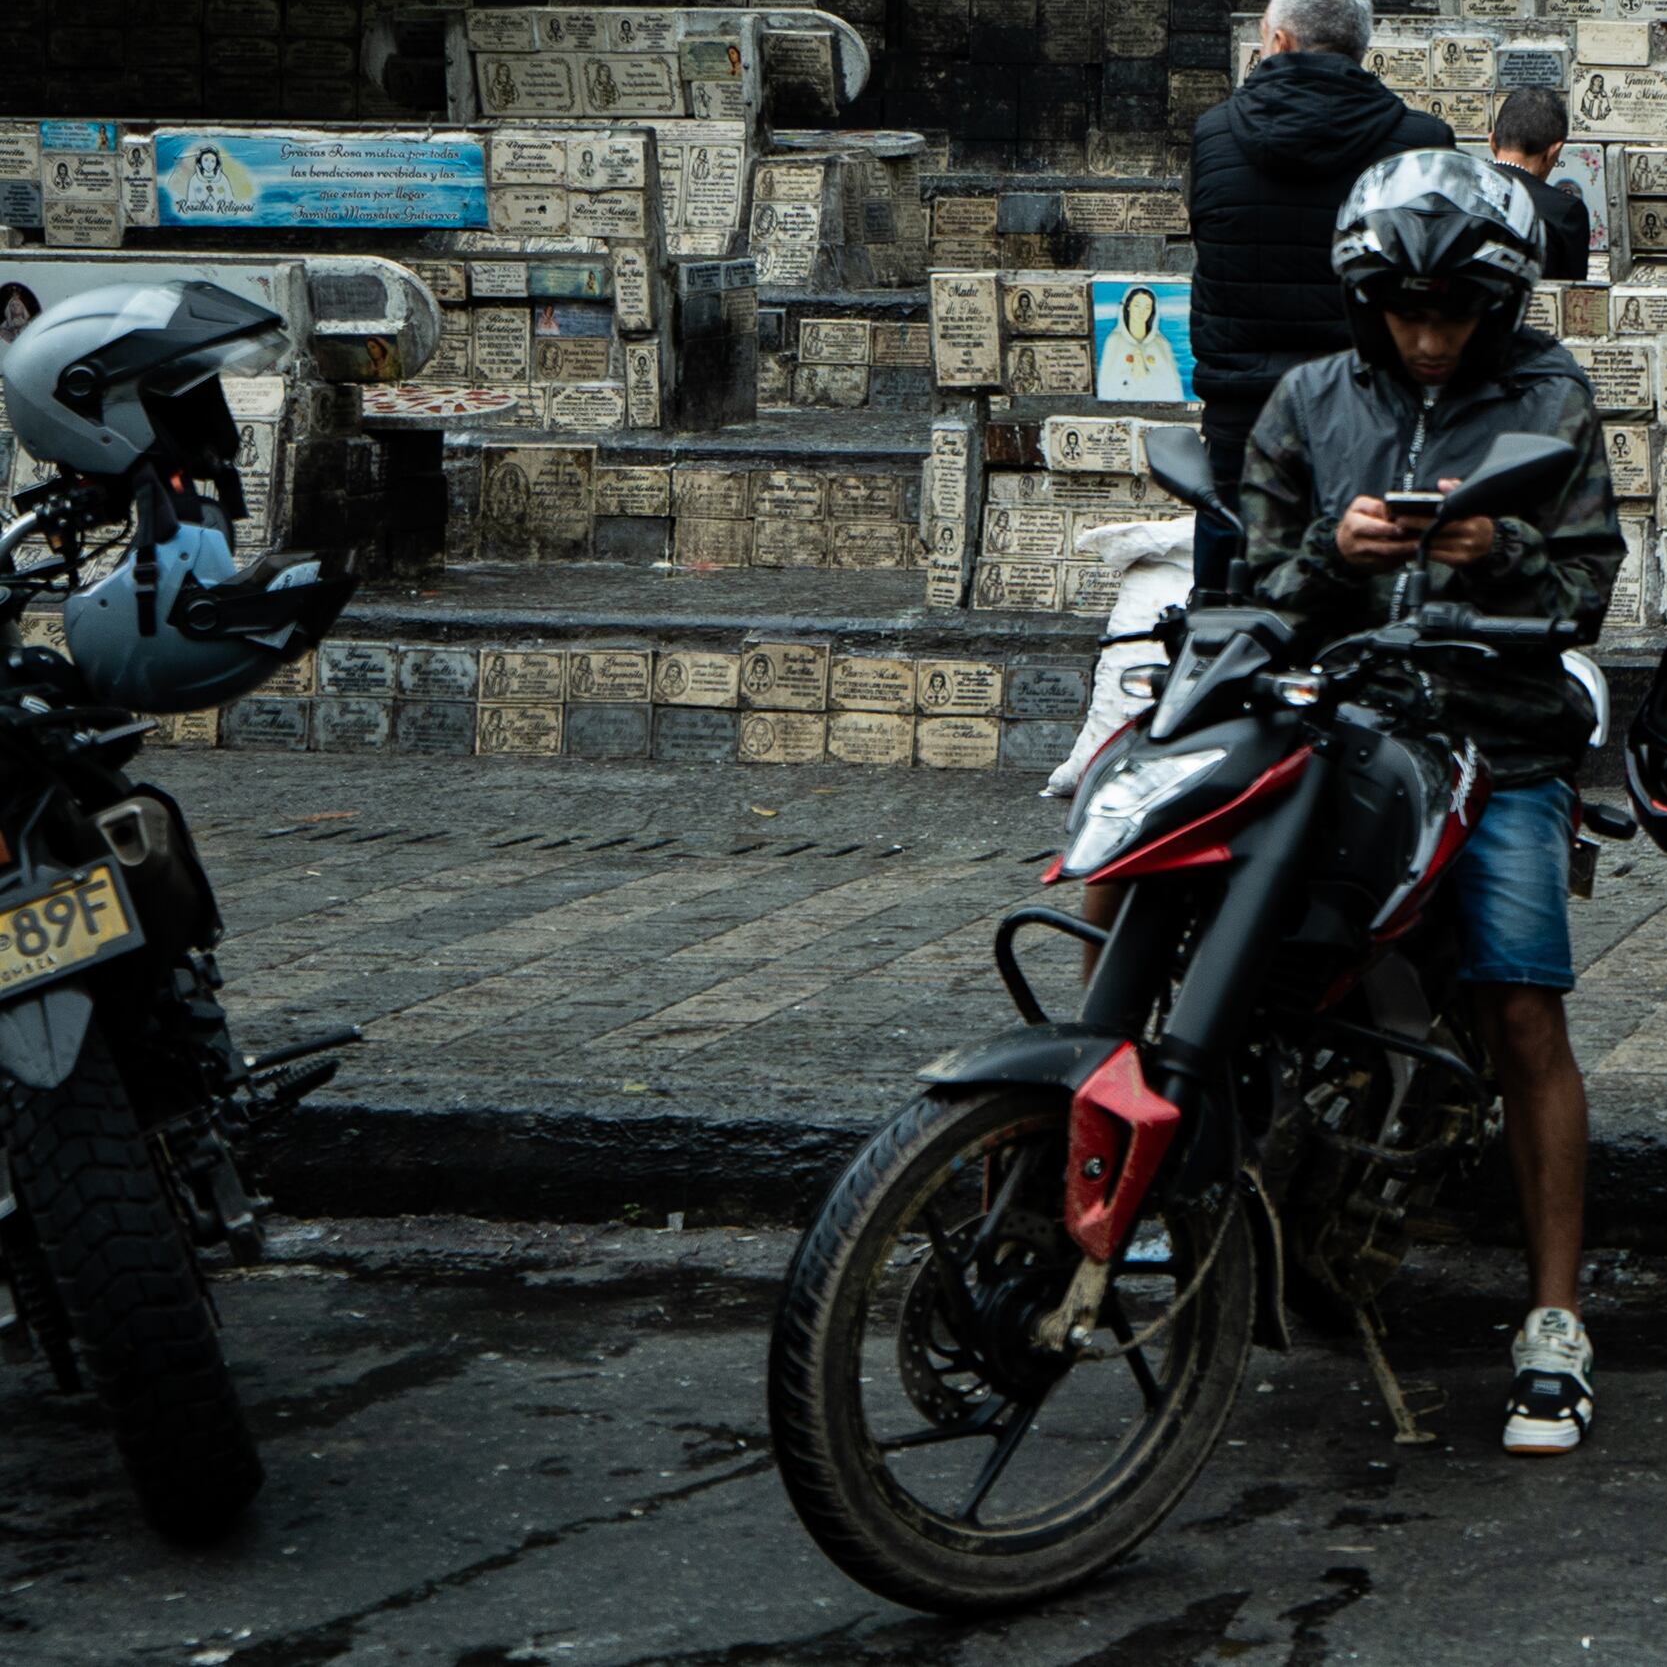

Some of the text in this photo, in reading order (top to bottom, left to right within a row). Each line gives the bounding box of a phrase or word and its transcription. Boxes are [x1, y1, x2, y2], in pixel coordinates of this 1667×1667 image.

[280, 144, 327, 161] Gracias
[328, 144, 362, 159] Rosa
[407, 149, 428, 163] por
[430, 146, 459, 160] todas
[291, 166, 455, 182] las bendiciones recibidas y las
[319, 190, 339, 201] que
[375, 190, 394, 201] por
[395, 188, 426, 201] llegar
[291, 205, 339, 221] Familia
[341, 205, 400, 221] Monsalve
[12, 880, 107, 957] 89F
